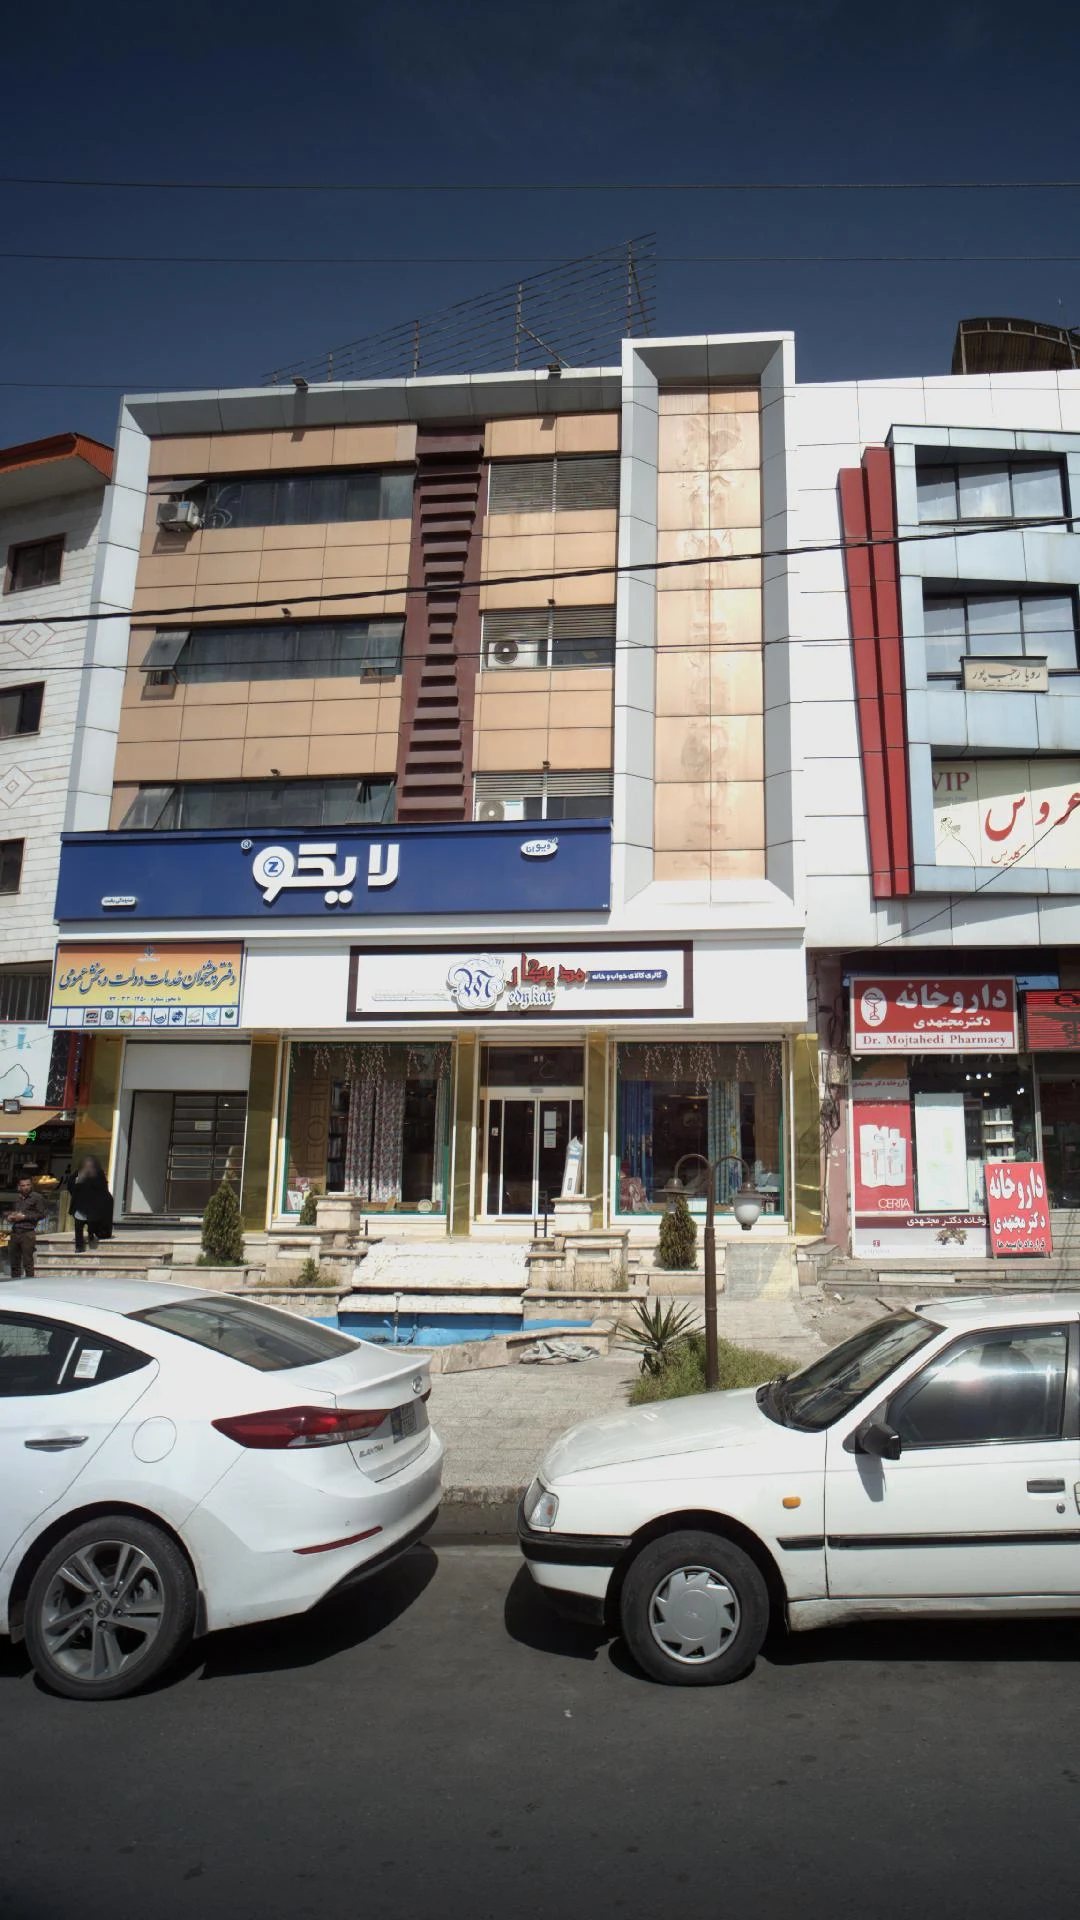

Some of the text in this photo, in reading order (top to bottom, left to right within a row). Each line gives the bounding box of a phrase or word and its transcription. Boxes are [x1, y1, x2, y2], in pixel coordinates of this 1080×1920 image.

[972, 667, 1041, 683] رویا رجب پور
[932, 771, 970, 792] VIP
[252, 843, 400, 903] لایکو
[108, 966, 144, 987] دولت
[181, 960, 219, 990] پیشخوان
[210, 961, 236, 992] دفتر
[505, 952, 586, 986] مدیکار
[591, 972, 605, 980] خانه
[610, 972, 627, 981] خواب
[627, 971, 645, 980] کالای
[644, 971, 662, 981] گالری
[58, 966, 88, 990] عمومی
[79, 962, 105, 996] بخش
[143, 970, 183, 987] خدمات
[895, 982, 1007, 1014] داروخانه
[913, 1016, 991, 1030] دکتر مجتهدی
[863, 1034, 1007, 1047] Dr. Mojtahedi Pharmacy
[989, 1167, 1044, 1209] داروخانه
[878, 1198, 911, 1209] CERITA
[906, 1216, 940, 1227] مجتهدی
[941, 1215, 962, 1226] دکتر
[993, 1211, 1046, 1235] دکتر مجتهدی
[1024, 1237, 1046, 1251] قرارداد
